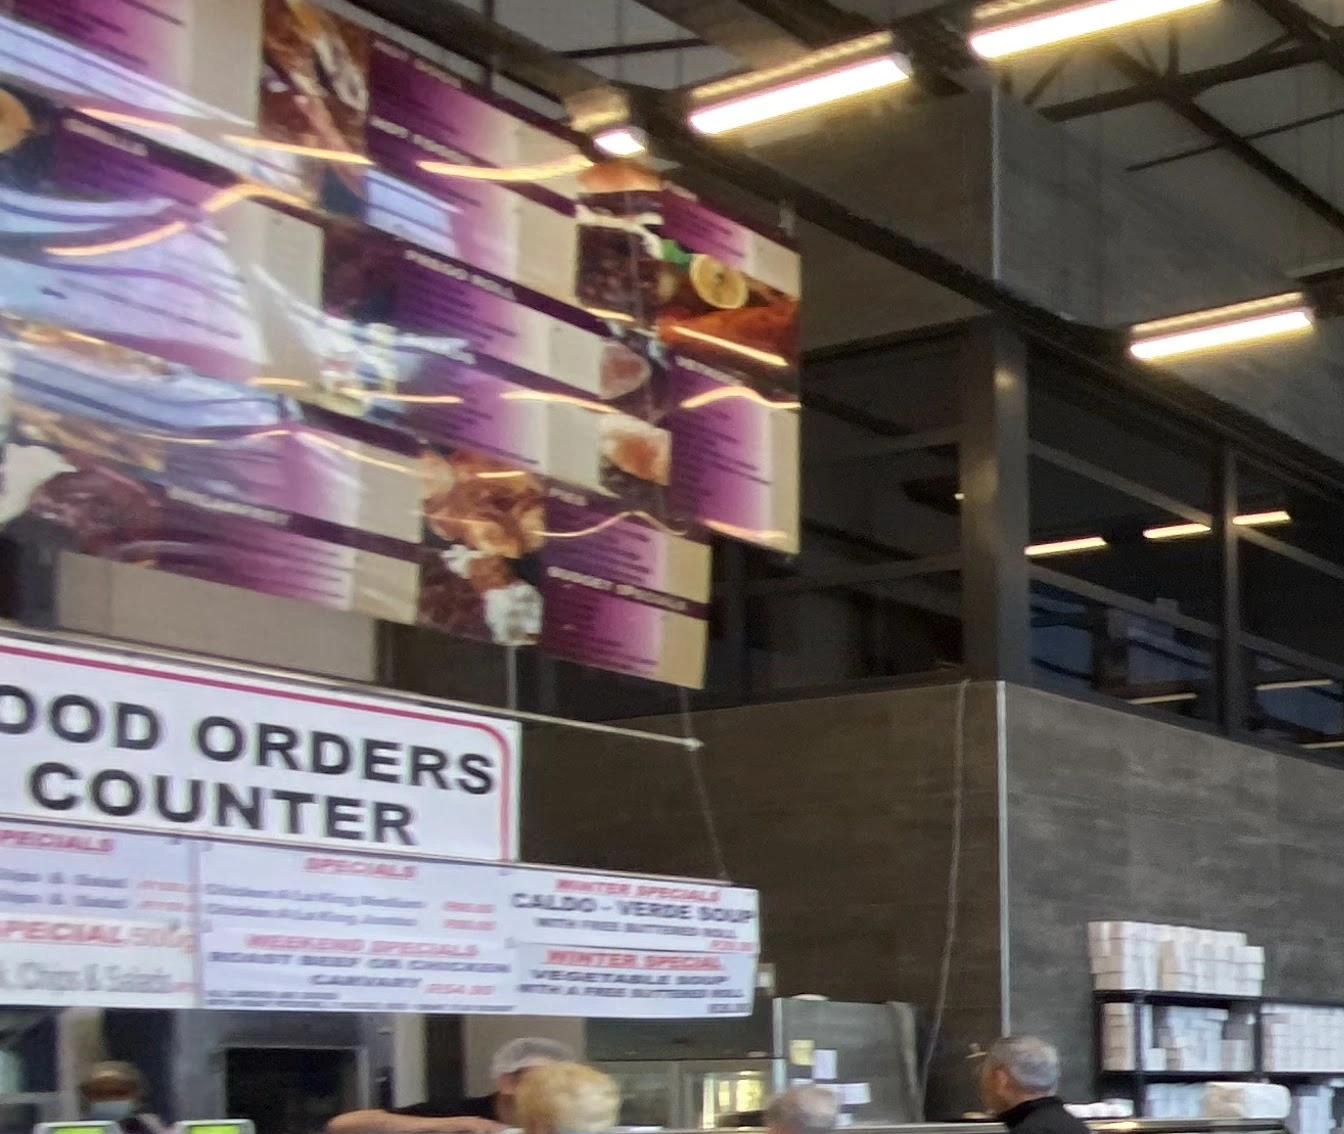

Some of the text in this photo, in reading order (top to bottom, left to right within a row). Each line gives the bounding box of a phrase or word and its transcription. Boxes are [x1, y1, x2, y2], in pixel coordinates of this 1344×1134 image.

[198, 715, 494, 796] ORDERS
[29, 761, 418, 846] COUNTER
[304, 857, 417, 880] SPECIALS
[511, 892, 597, 913] CALDO
[616, 900, 693, 919] VERDE
[696, 906, 754, 923] SOUP
[0, 919, 127, 944] PECIAL
[546, 949, 637, 968] WINTER
[530, 969, 671, 985] VEGETABLE
